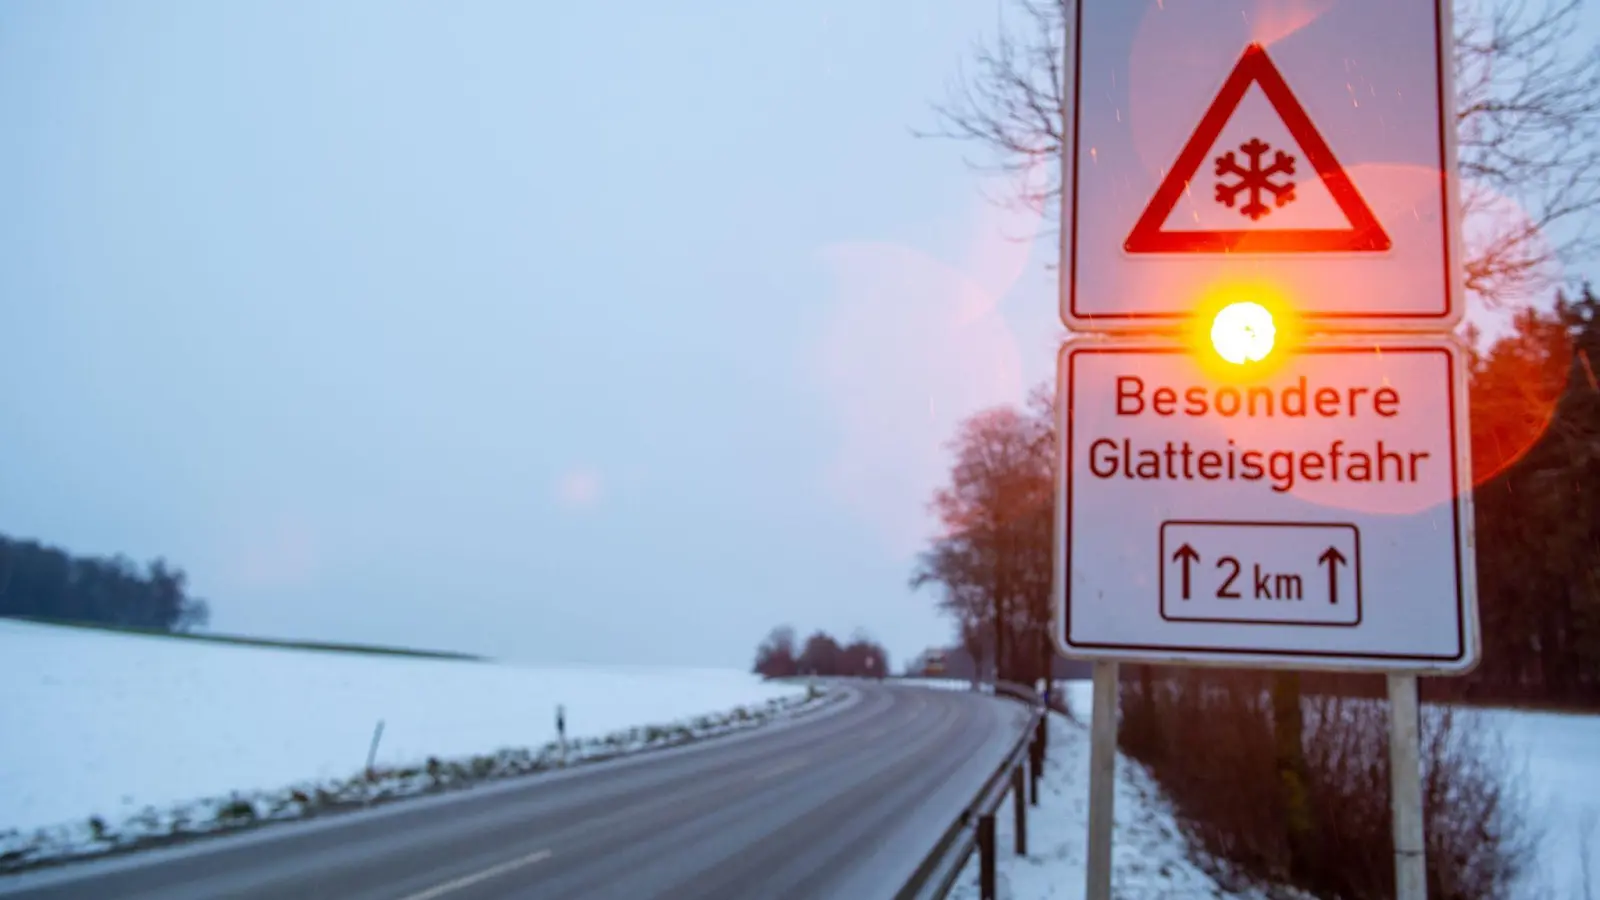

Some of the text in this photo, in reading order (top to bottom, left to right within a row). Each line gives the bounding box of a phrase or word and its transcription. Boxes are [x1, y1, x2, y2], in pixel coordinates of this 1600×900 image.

[1115, 375, 1401, 418] Besondere
[1088, 437, 1430, 493] Glatteisgefahr
[1215, 556, 1303, 601] 2 km
